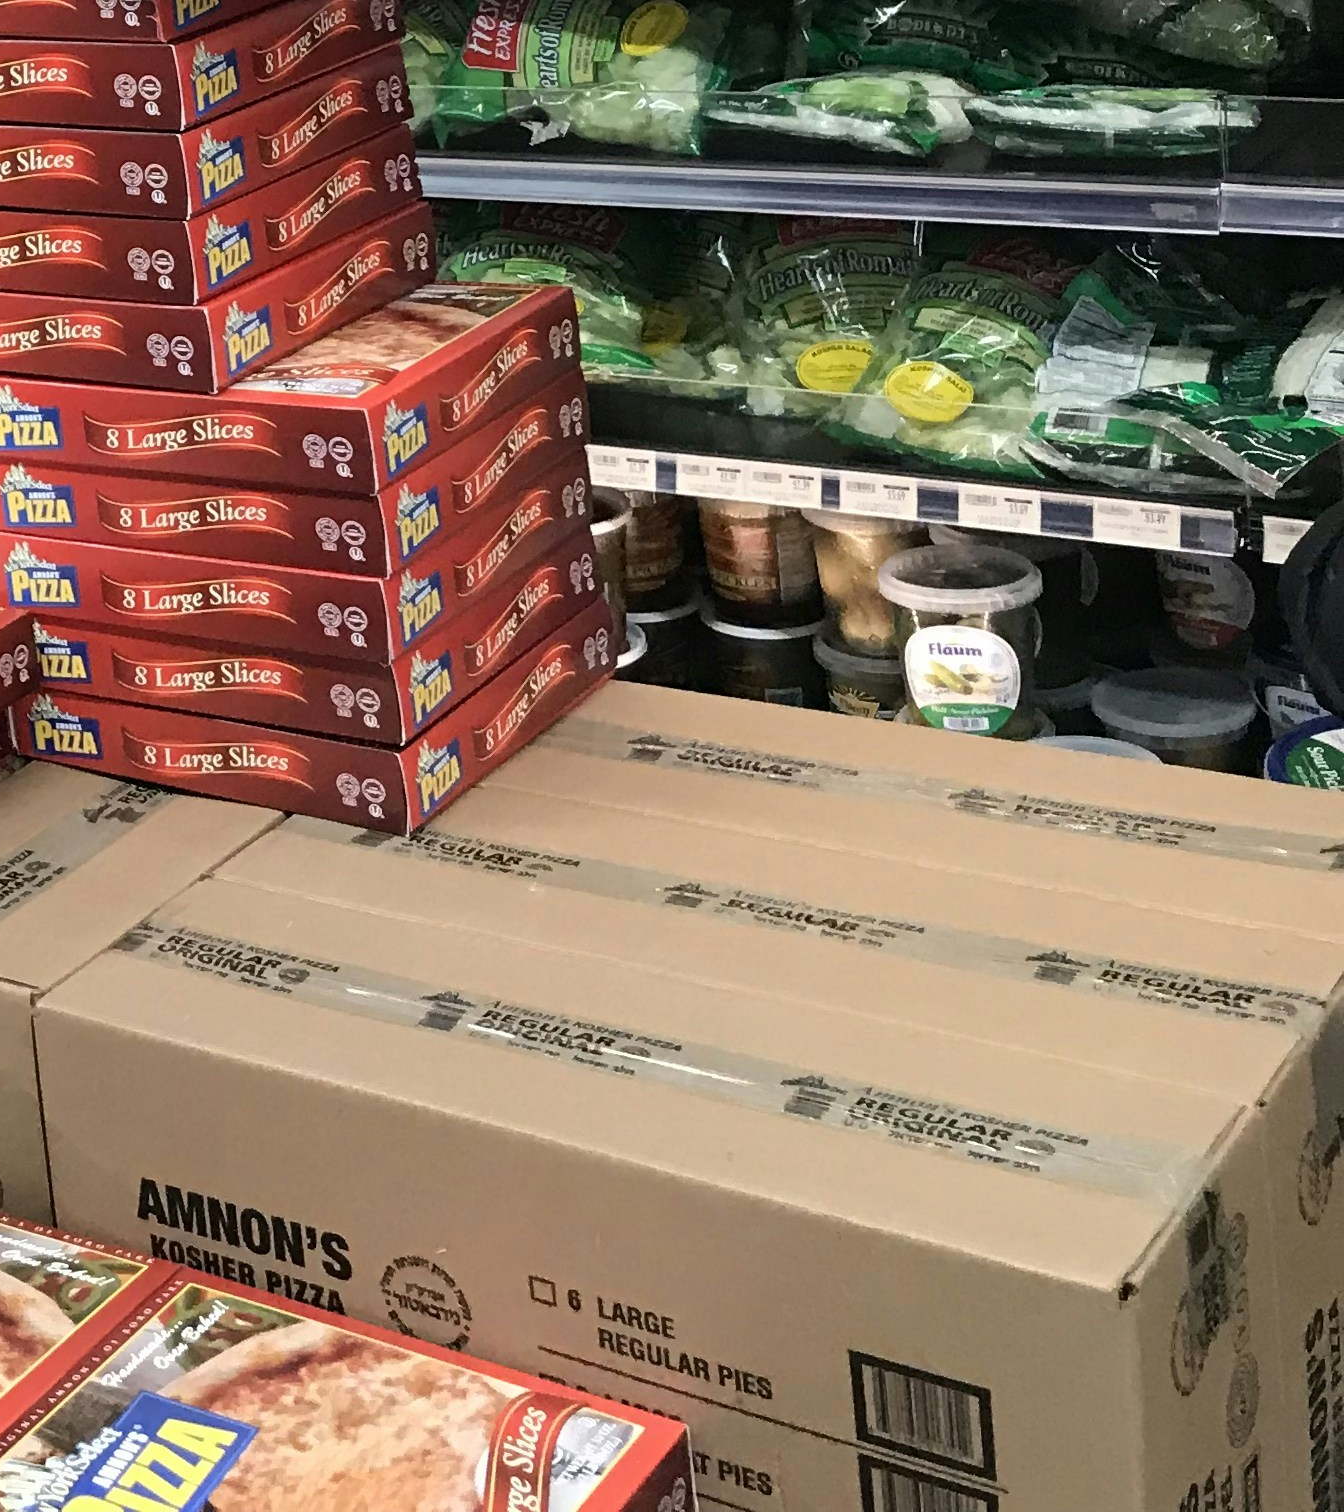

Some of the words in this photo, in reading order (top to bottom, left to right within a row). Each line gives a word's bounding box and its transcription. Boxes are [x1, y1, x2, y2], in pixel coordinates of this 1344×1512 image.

[9, 62, 69, 88] Slices
[104, 427, 119, 448] 8
[125, 423, 189, 453] Large
[192, 415, 255, 443] Slices
[927, 641, 983, 659] Flaum
[33, 725, 100, 757] PIZZA
[143, 744, 158, 766] 8
[162, 743, 225, 773] Large
[227, 739, 290, 772] Slices
[166, 935, 282, 969] REGULAR
[137, 1177, 353, 1281] AMNON'S
[149, 1233, 257, 1287] KOSHER
[265, 1269, 346, 1316] PIZZA
[567, 1289, 582, 1312] 6
[597, 1296, 676, 1339] LARGE
[598, 1328, 710, 1382] REGULAR
[717, 1364, 773, 1400] PIES
